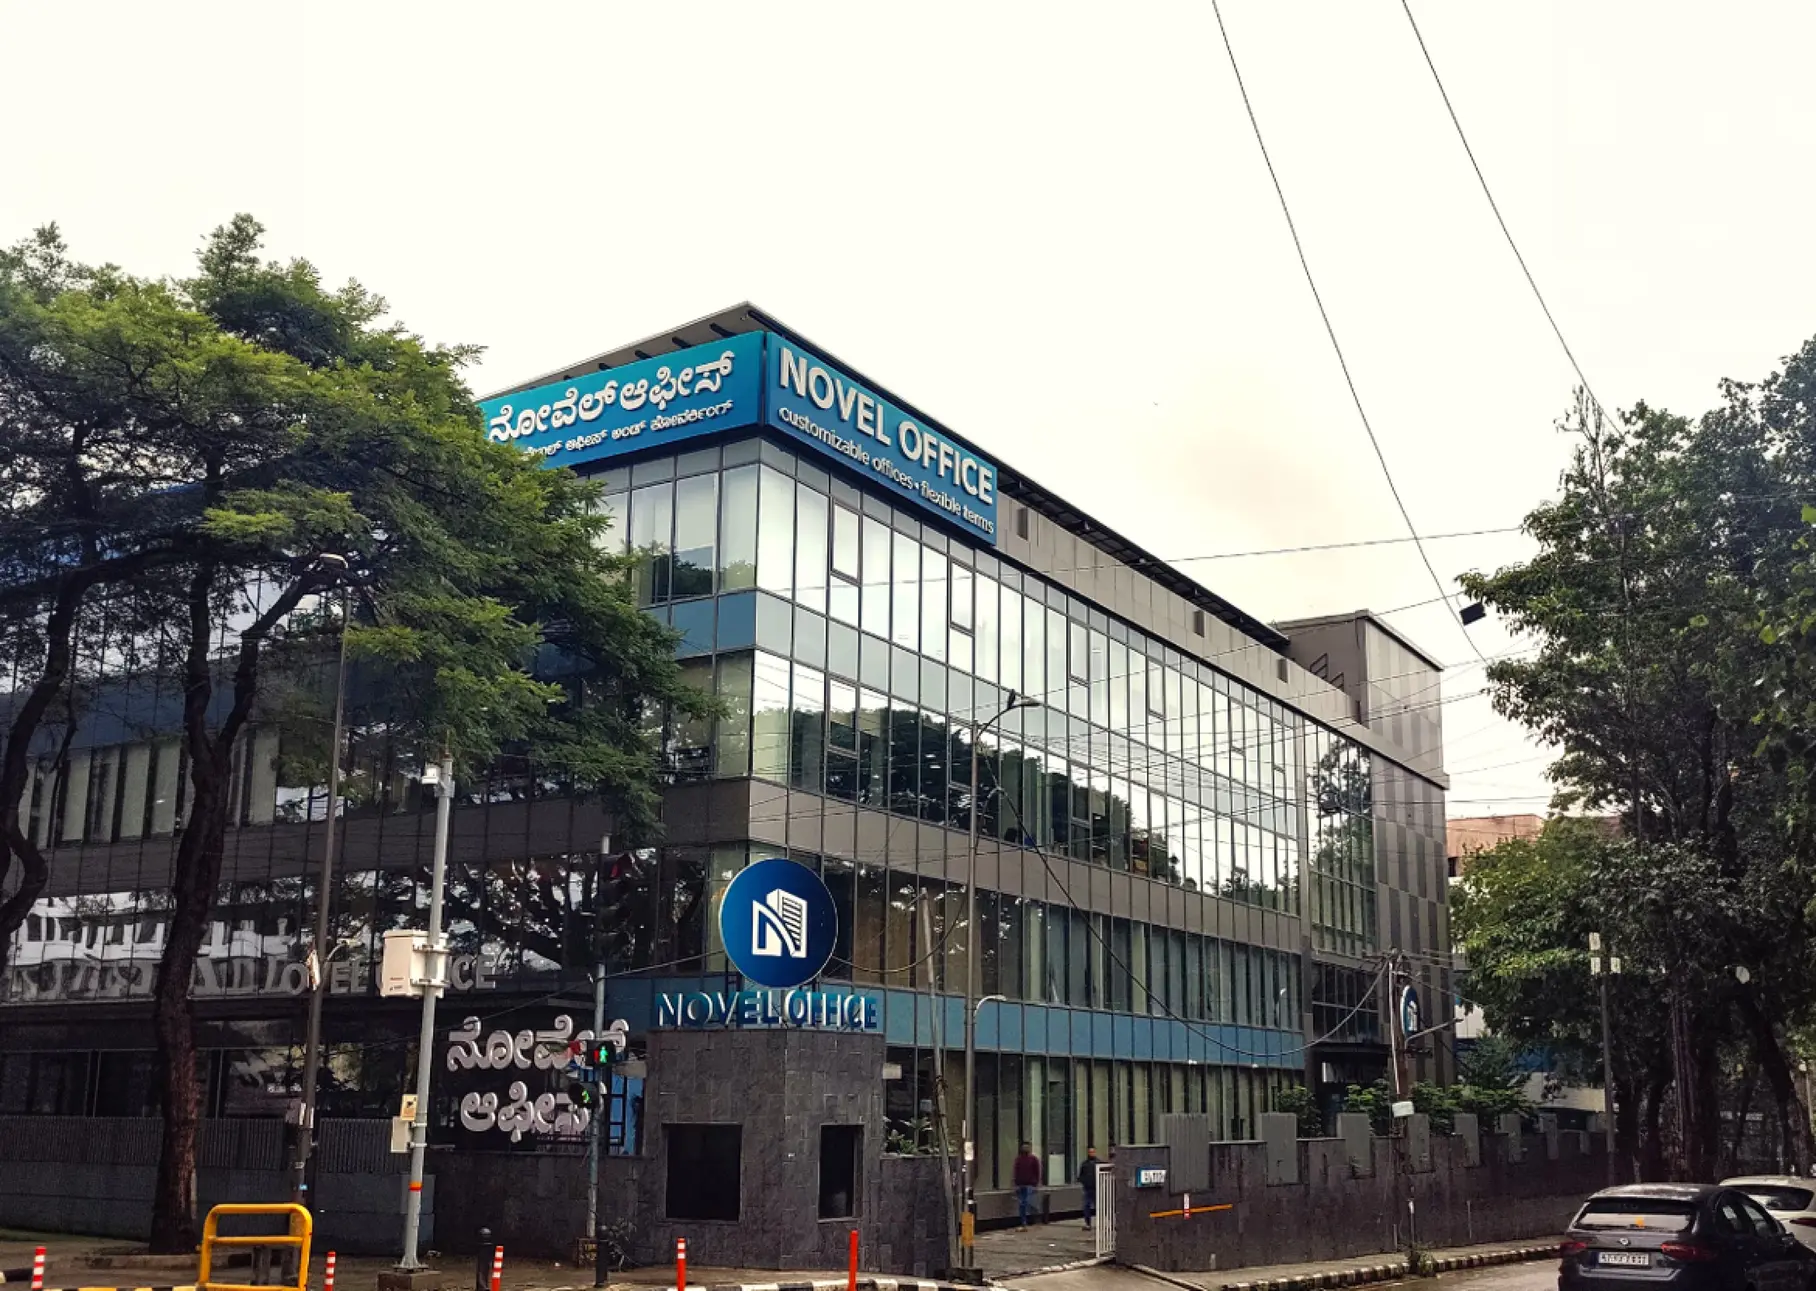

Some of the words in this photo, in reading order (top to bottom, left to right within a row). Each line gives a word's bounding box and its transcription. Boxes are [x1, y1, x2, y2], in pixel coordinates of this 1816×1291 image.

[488, 379, 619, 443] ನೋವೆಲ್
[620, 350, 735, 411] ಆಫೀಸ್
[779, 346, 891, 446] NOVEL
[898, 420, 993, 505] OFFICE
[871, 456, 914, 490] offices
[919, 480, 962, 517] flexible
[963, 503, 995, 535] terms
[655, 990, 783, 1028] NOVEL
[784, 989, 878, 1030] OFFICE
